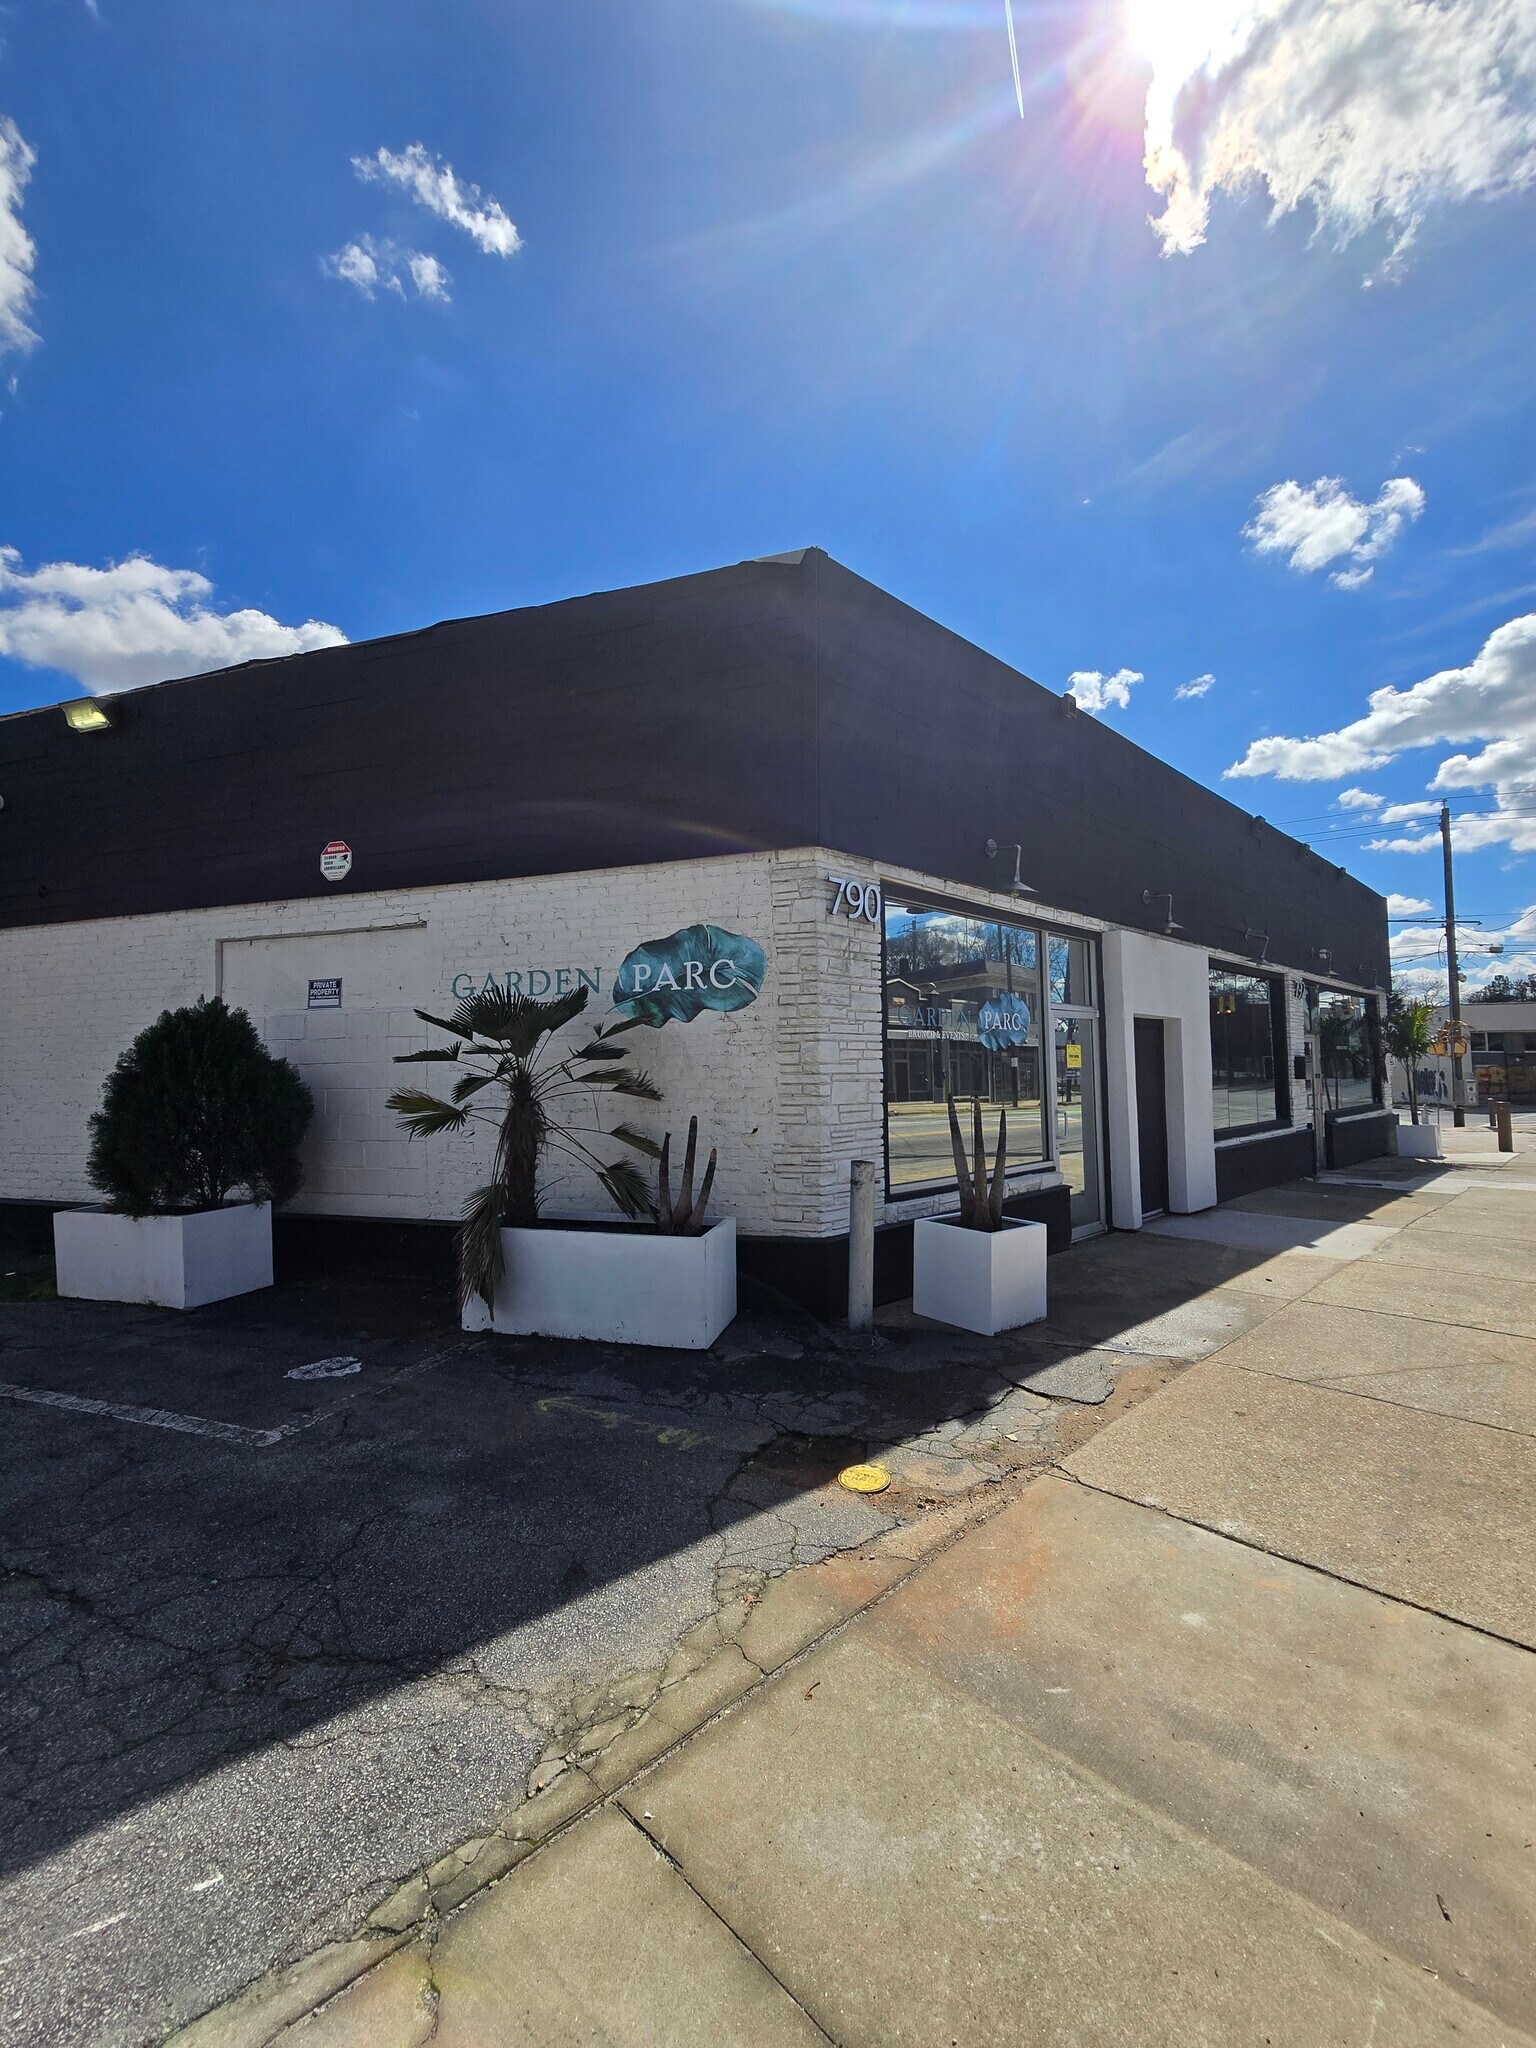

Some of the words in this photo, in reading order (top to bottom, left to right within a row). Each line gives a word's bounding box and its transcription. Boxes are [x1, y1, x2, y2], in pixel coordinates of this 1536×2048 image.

[828, 876, 881, 923] 790
[313, 981, 337, 989] PRIVATE
[451, 967, 602, 1000] GARDEN
[632, 959, 737, 993] PARC
[310, 988, 340, 996] PROPERTY
[898, 1004, 971, 1029] GARDEN
[984, 1011, 1022, 1031] PARC
[908, 1029, 935, 1039] BRUNCH
[936, 1031, 941, 1039] &
[941, 1030, 965, 1040] EVENTS
